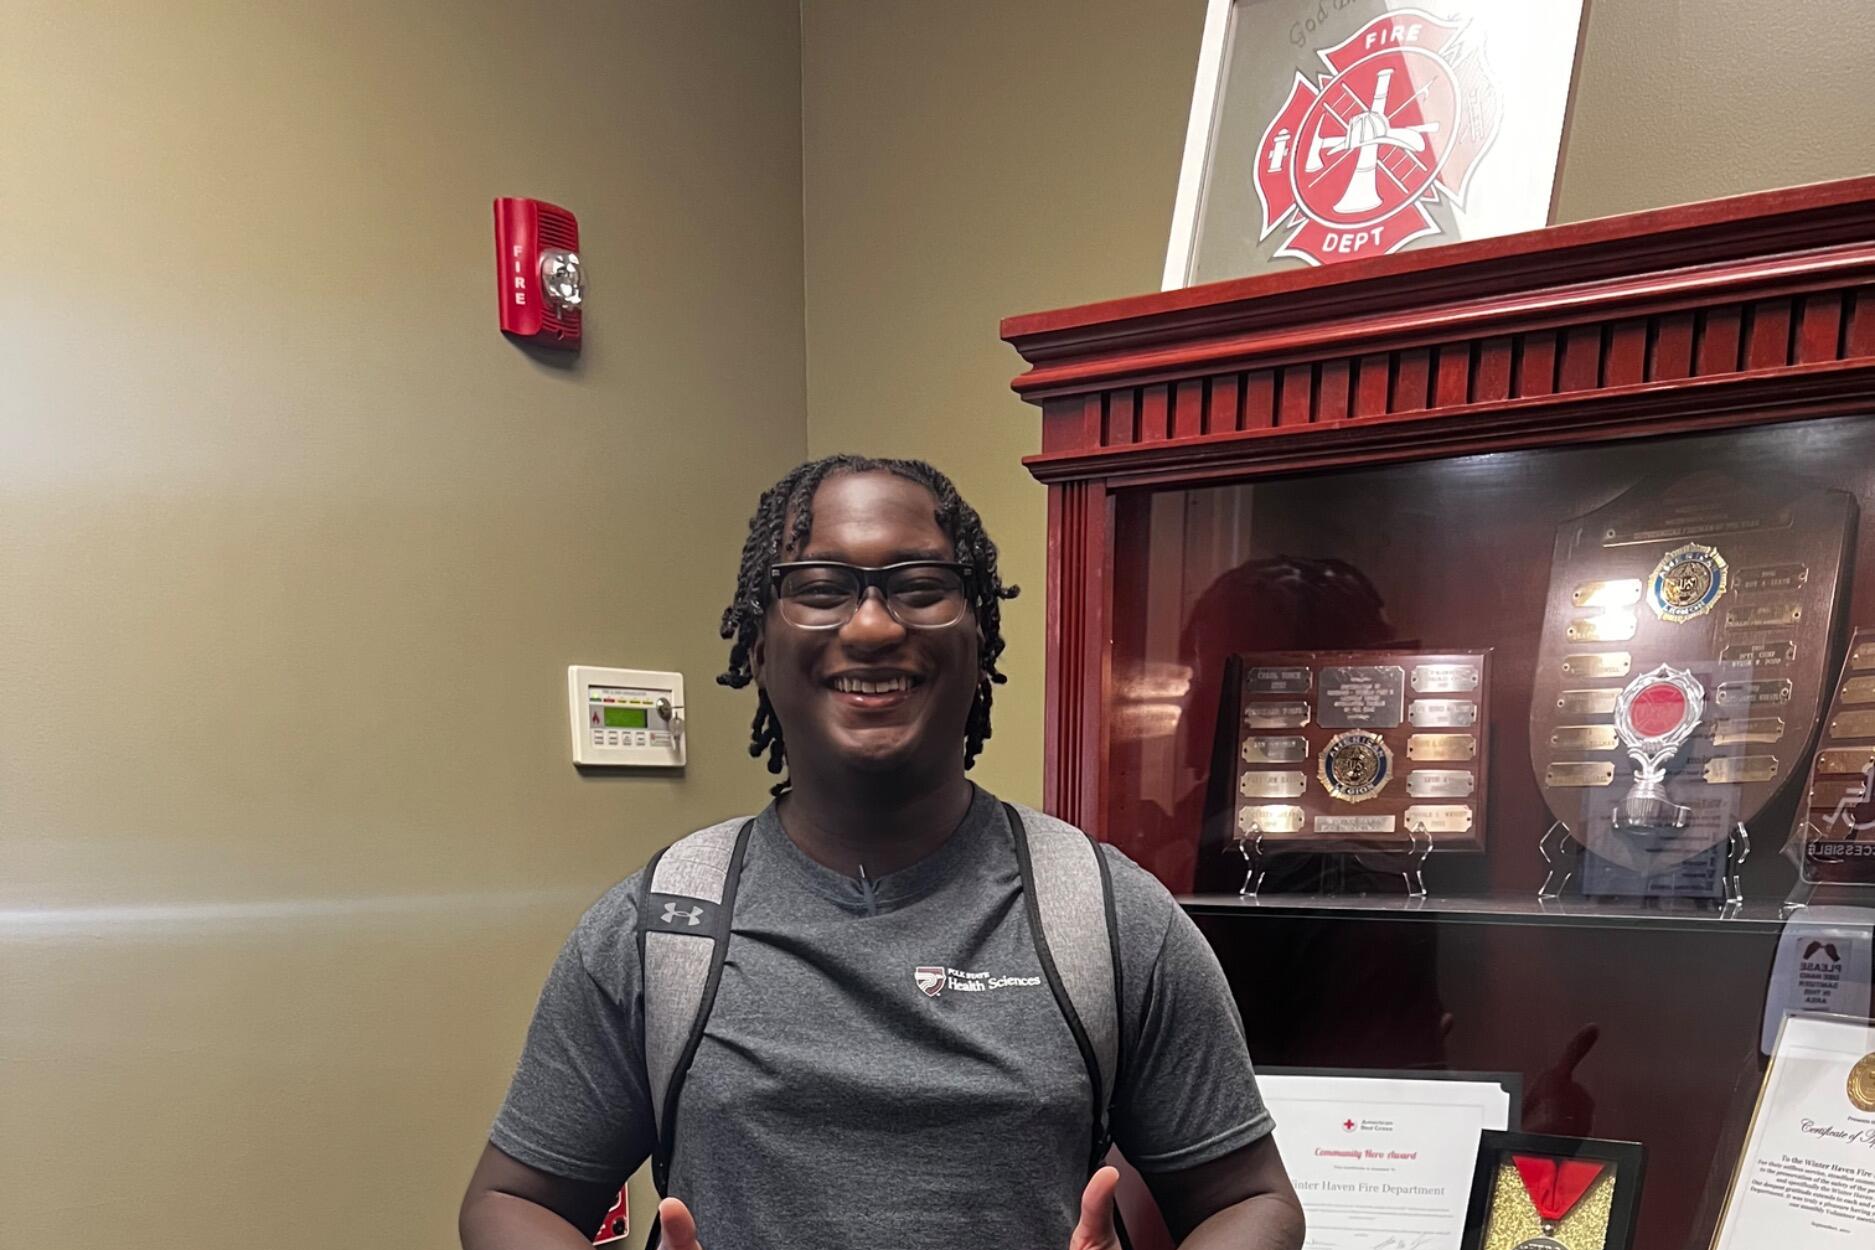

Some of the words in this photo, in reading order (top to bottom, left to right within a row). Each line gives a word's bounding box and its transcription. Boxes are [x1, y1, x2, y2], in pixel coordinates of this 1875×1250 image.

[1289, 2, 1328, 48] God
[1364, 23, 1422, 50] FIRE
[1321, 226, 1385, 253] DEPT
[513, 245, 526, 305] FIRE
[948, 977, 986, 992] Health
[988, 975, 1042, 990] Sciences
[1800, 1117, 1848, 1139] Certificate
[1845, 1130, 1863, 1144] of
[1315, 1148, 1362, 1160] Community
[1292, 1179, 1319, 1191] inter
[1322, 1180, 1355, 1192] Haven
[1358, 1182, 1380, 1193] Fire
[1382, 1183, 1446, 1196] Department
